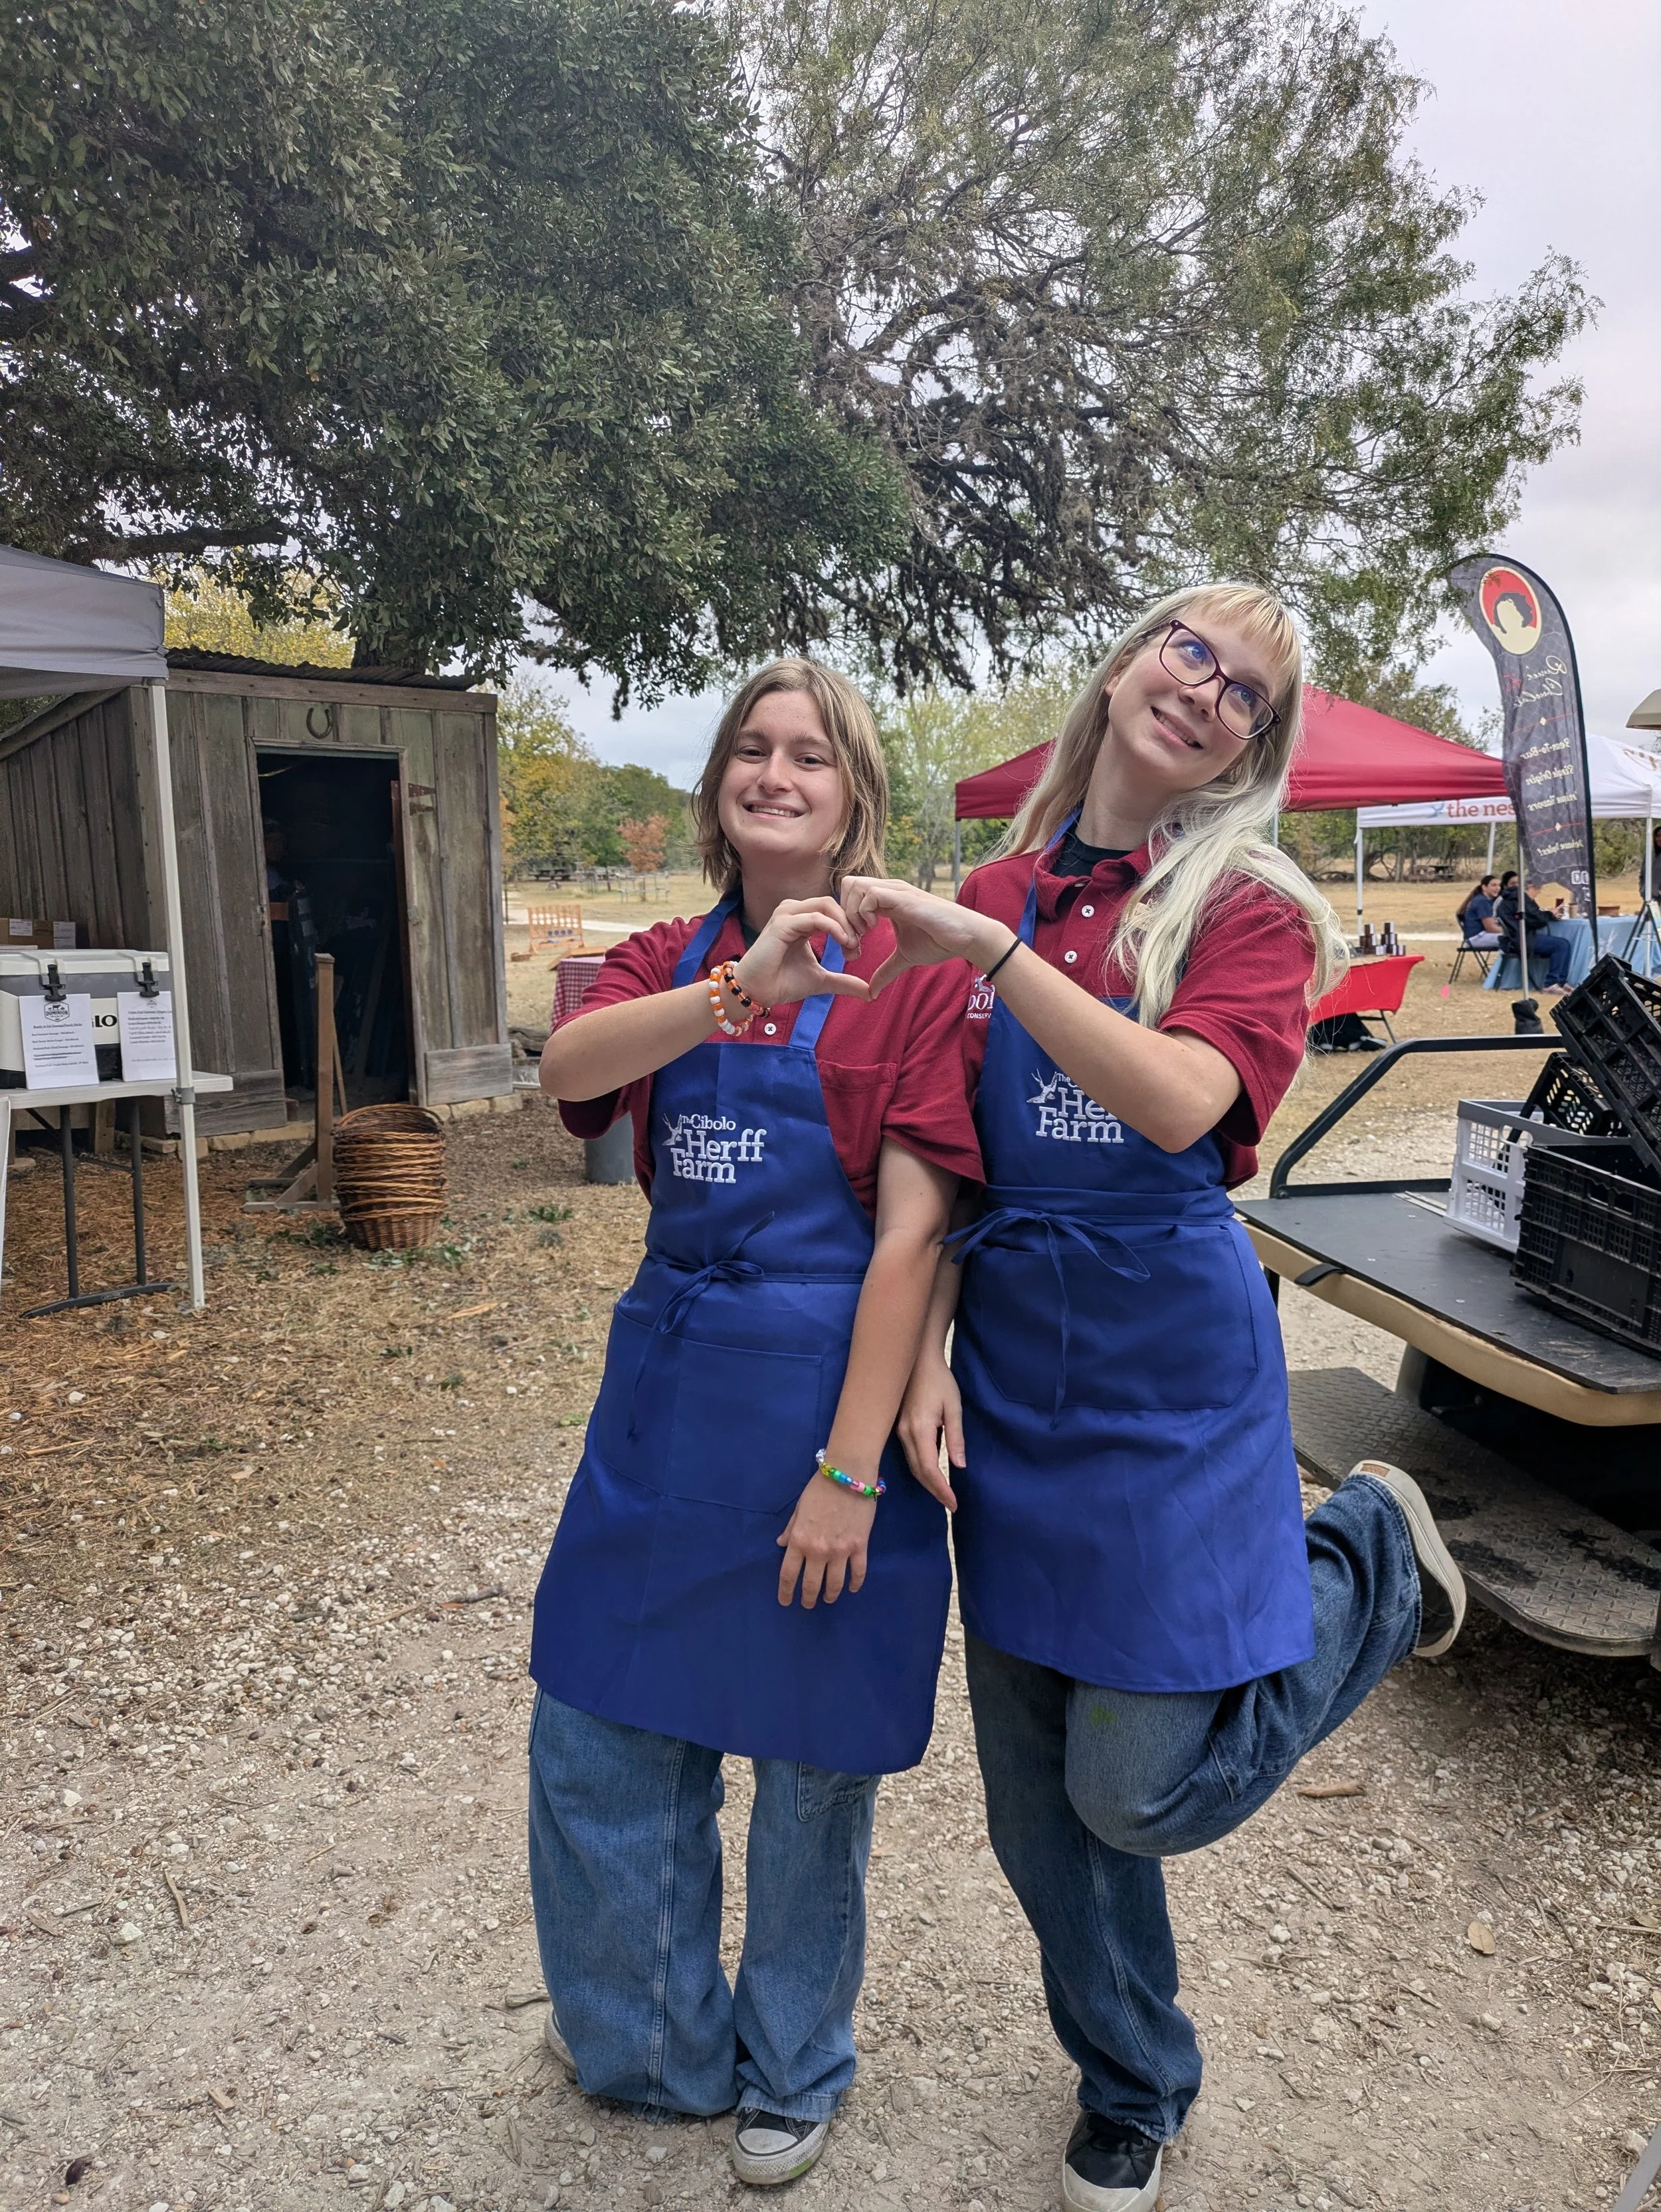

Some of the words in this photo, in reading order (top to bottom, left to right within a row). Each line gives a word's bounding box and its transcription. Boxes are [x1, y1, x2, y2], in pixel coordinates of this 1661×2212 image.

[1447, 799, 1479, 818] the
[92, 1015, 118, 1028] LO
[1058, 1072, 1071, 1083] The
[682, 1116, 694, 1124] The
[692, 1114, 736, 1131] Cibolo
[1036, 1106, 1124, 1144] Farm
[684, 1128, 767, 1162] Herff
[670, 1148, 737, 1184] Farm
